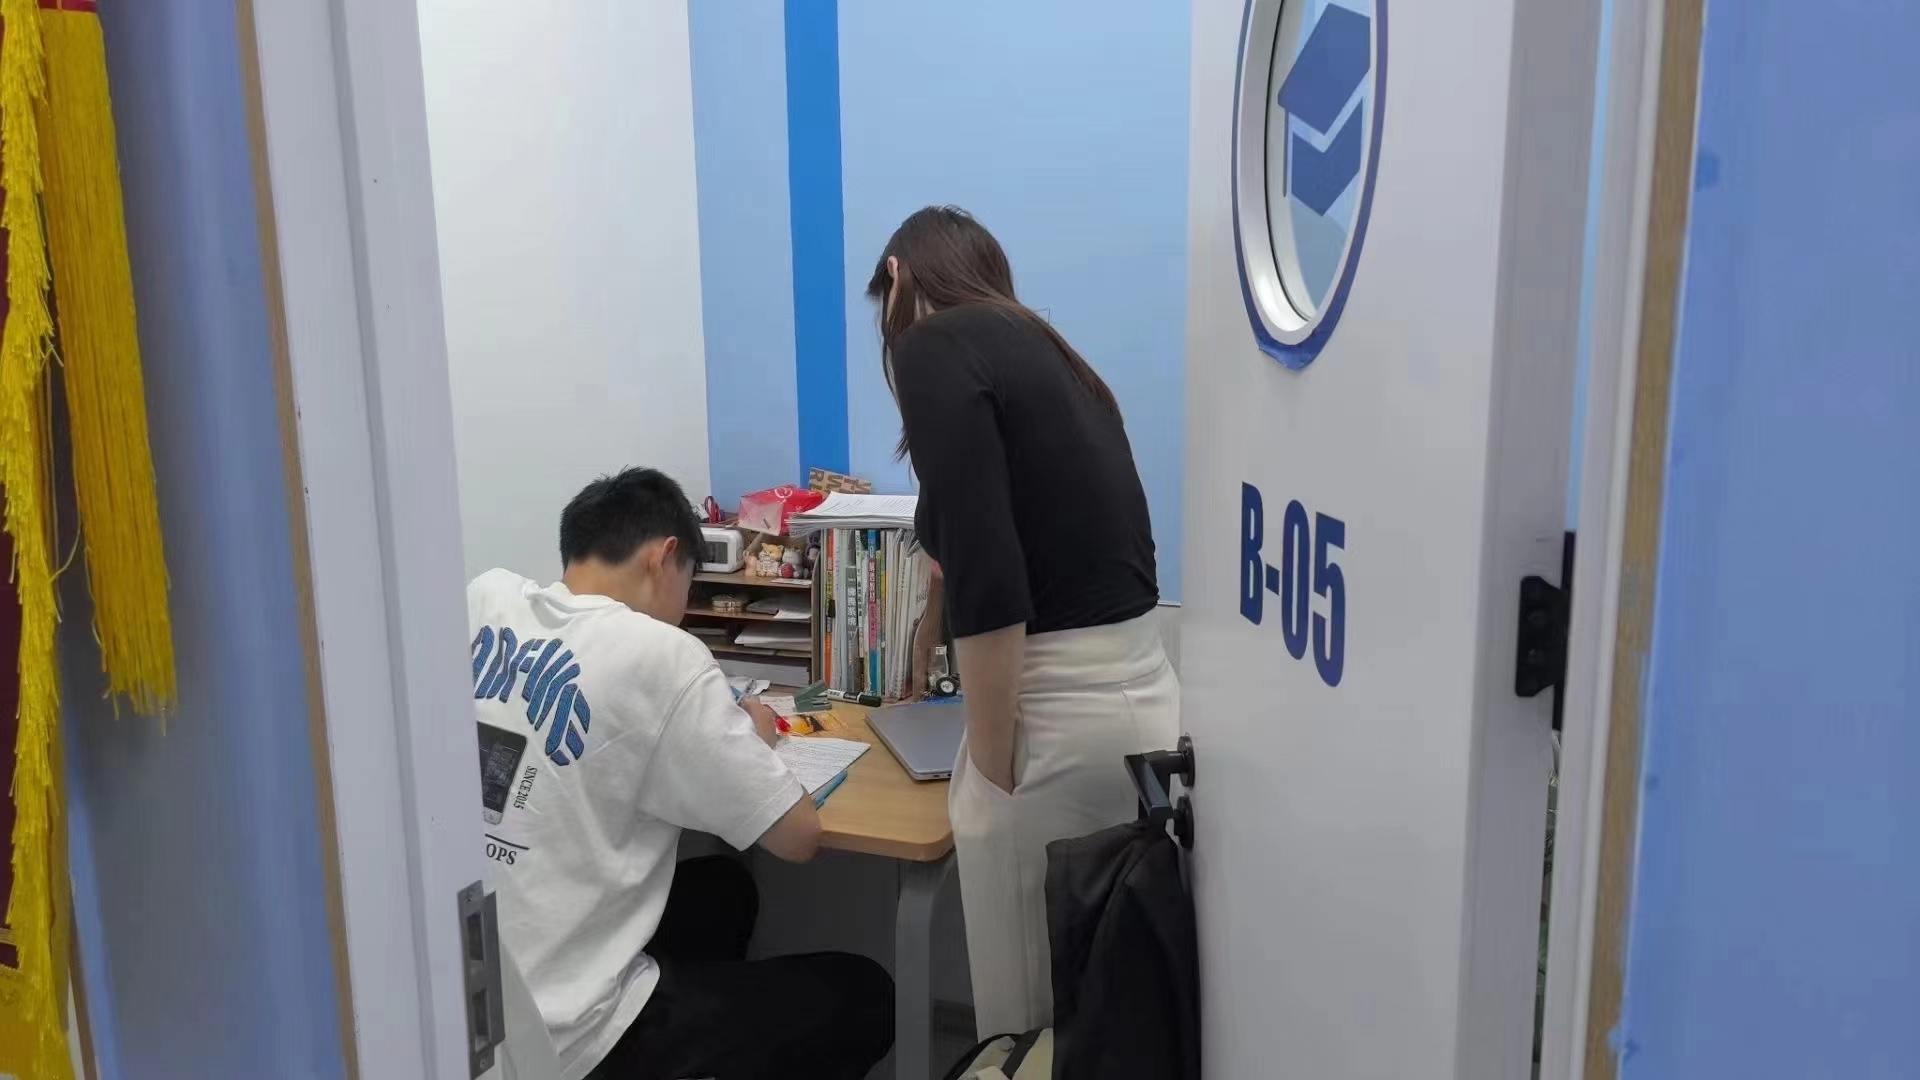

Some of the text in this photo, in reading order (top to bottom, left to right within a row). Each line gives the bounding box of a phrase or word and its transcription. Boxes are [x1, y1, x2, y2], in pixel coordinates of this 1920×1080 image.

[1240, 481, 1346, 687] B-05
[513, 765, 538, 810] SINCE 2015
[486, 843, 517, 865] OPS
